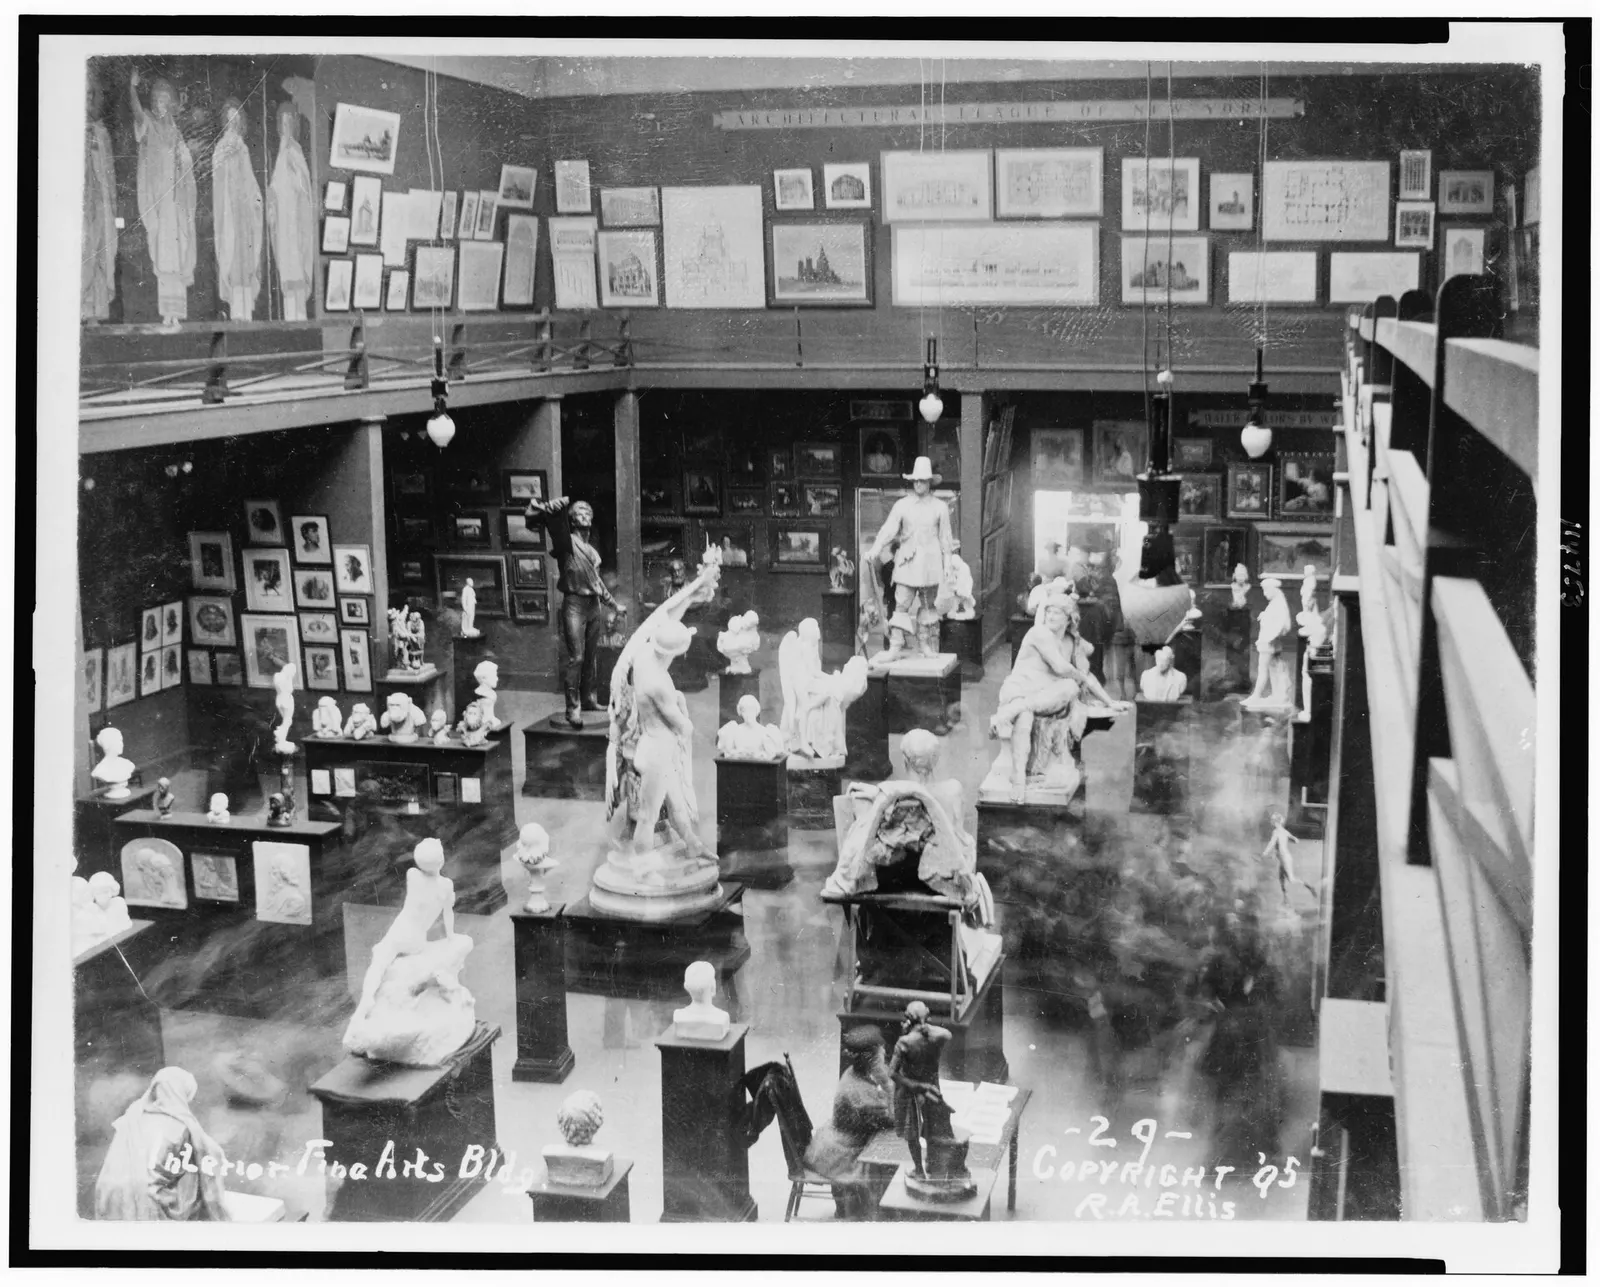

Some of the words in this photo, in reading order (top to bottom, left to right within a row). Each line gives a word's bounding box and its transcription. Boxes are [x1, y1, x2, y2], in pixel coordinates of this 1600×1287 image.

[736, 108, 938, 126] ARCHITECTURAL
[958, 103, 1056, 120] LEAGUE
[1079, 103, 1107, 118] OF
[1132, 102, 1182, 117] NEW
